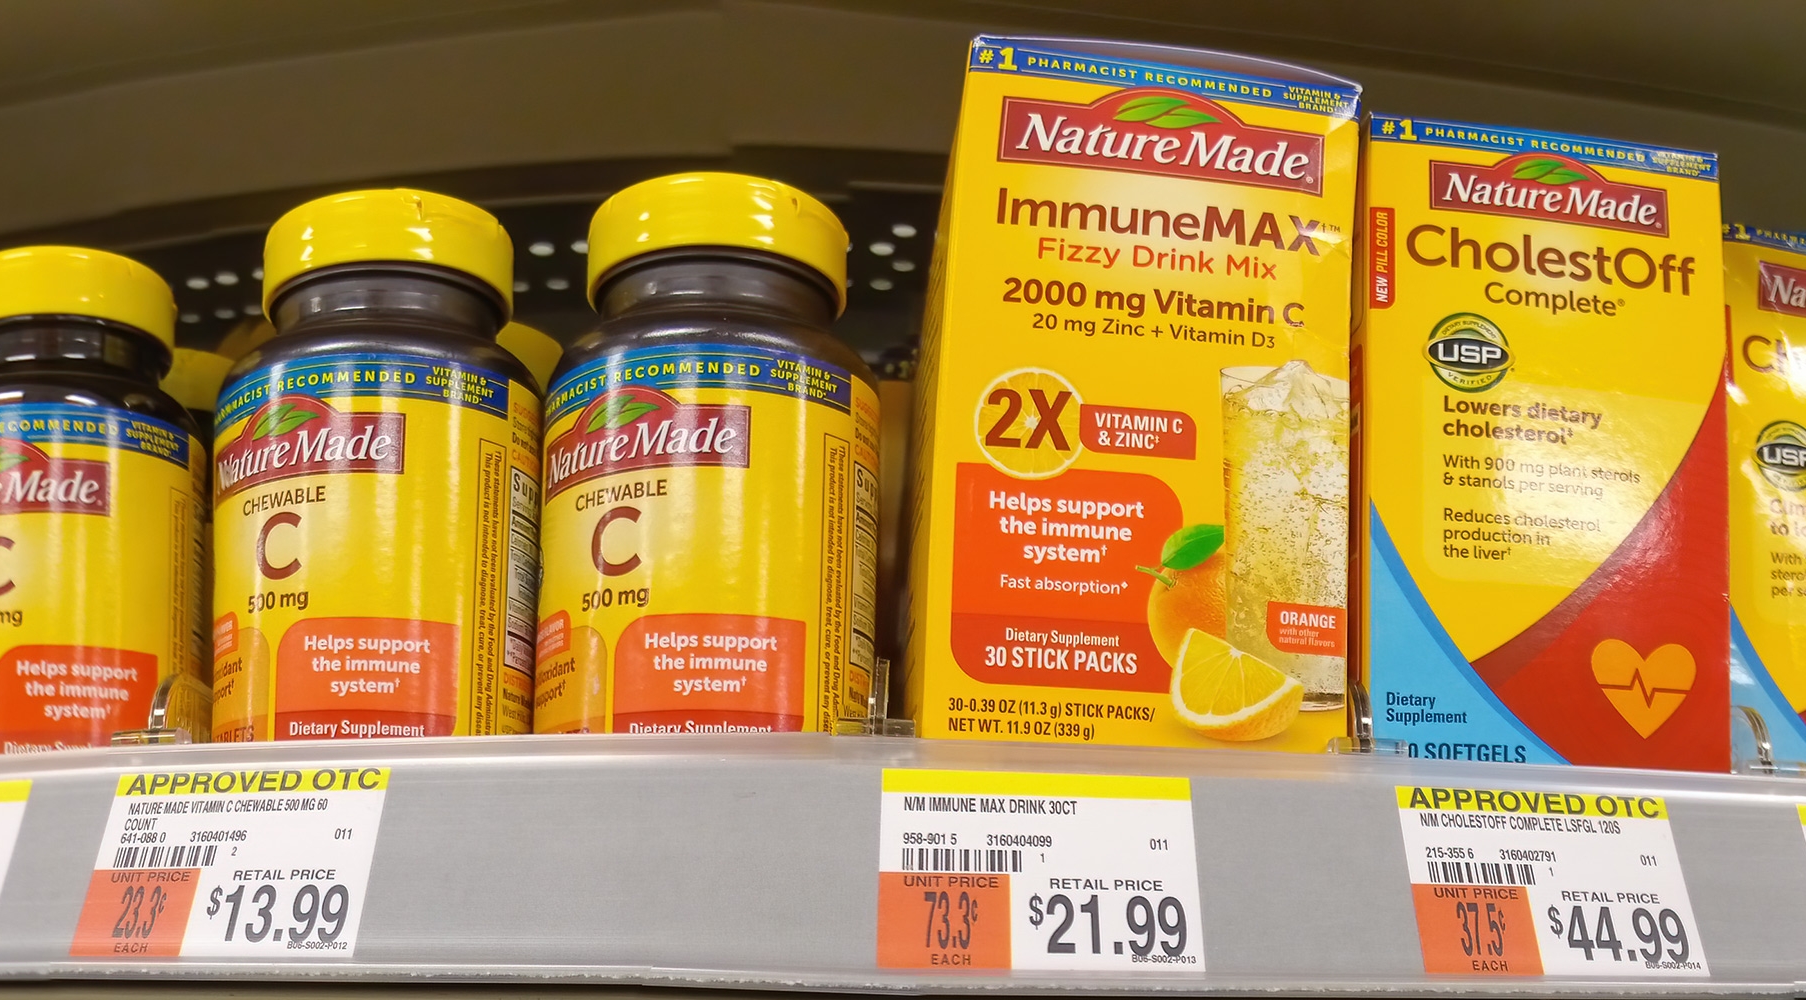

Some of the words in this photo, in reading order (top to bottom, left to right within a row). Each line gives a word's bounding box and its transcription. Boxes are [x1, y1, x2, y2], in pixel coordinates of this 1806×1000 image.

[1027, 55, 1137, 80] PHARMACIST
[1145, 71, 1272, 98] RECOMMENDED
[1376, 212, 1388, 244] COLOR
[1038, 237, 1120, 270] Fizzy
[1133, 245, 1214, 274] Drink
[1226, 254, 1277, 280] Mix
[1376, 248, 1388, 272] PILL
[1406, 224, 1695, 296] CholestOff
[1002, 278, 1086, 308] 2000
[1094, 287, 1145, 317] mg
[1154, 289, 1275, 323] Vitamin
[1283, 302, 1304, 327] C
[1376, 276, 1388, 302] NEW
[1032, 314, 1057, 329] 20
[1063, 320, 1096, 337] mg
[1102, 318, 1145, 336] Zinc
[1169, 323, 1244, 345] Vitamin
[1438, 343, 1500, 365] USP
[986, 389, 1072, 451] 2X
[1094, 412, 1167, 433] VITAMIN
[1172, 418, 1182, 435] C
[1443, 396, 1522, 418] Lowers
[1527, 402, 1602, 430] dietary
[576, 479, 667, 512] CHEWABLE
[989, 491, 1052, 515] Helps
[1056, 498, 1144, 519] support
[591, 506, 642, 577] C
[999, 517, 1037, 535] the
[1041, 519, 1132, 541] immune
[1280, 610, 1336, 629] ORANGE
[985, 646, 1008, 667] 30
[1012, 647, 1067, 671] STICK
[1074, 650, 1137, 674] PACKS
[127, 768, 306, 795] APPROVED
[313, 769, 383, 791] OTC
[191, 800, 226, 813] VITAMIN
[228, 802, 234, 812] C
[235, 799, 283, 813] CHEWABLE
[285, 799, 300, 812] 500
[302, 799, 315, 811] MG
[316, 798, 327, 810] 60
[904, 797, 925, 812] N/M
[929, 798, 976, 813] IMMUNE
[980, 800, 1006, 814] MAX
[1009, 800, 1045, 814] DRINK
[1049, 801, 1077, 815] 30CT
[1409, 788, 1587, 816] APPROVED
[1595, 796, 1659, 820] OTC
[1050, 878, 1109, 890] RETAIL
[1115, 880, 1163, 891] PRICE
[206, 885, 348, 943] $13.99
[1029, 893, 1187, 956] $21.99
[1548, 905, 1690, 964] $44.99
